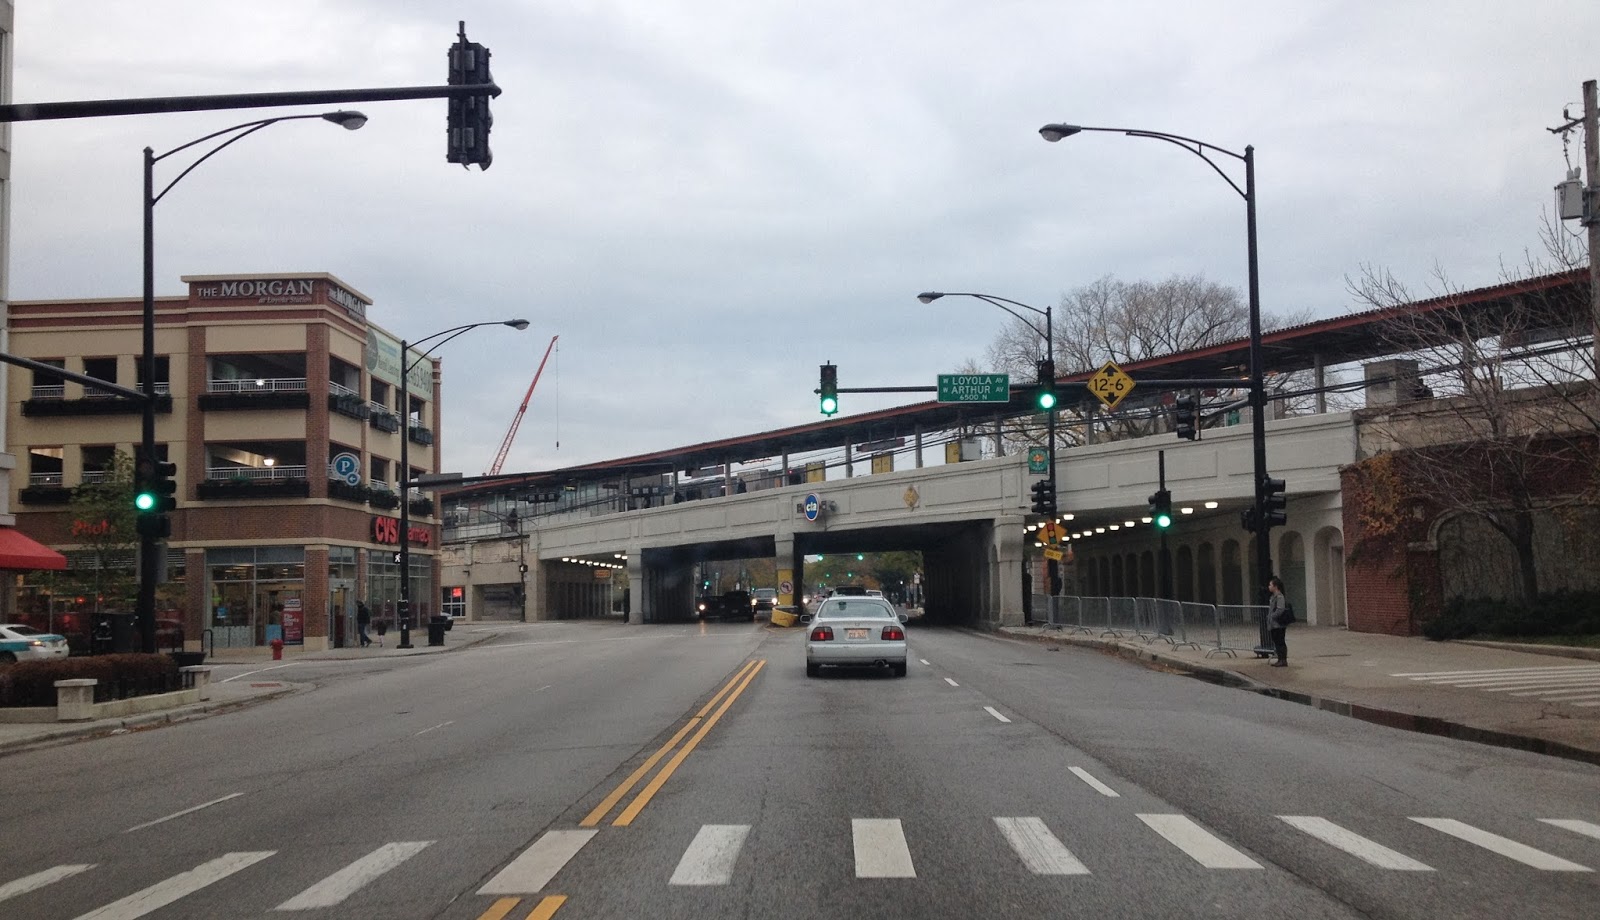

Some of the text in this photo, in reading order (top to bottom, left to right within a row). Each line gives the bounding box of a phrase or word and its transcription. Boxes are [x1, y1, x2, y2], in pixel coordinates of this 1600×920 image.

[197, 280, 314, 298] THE MORGAN
[952, 376, 992, 385] LOYOLA
[951, 385, 991, 394] ARTHUR
[341, 460, 351, 472] P
[806, 501, 817, 512] cta
